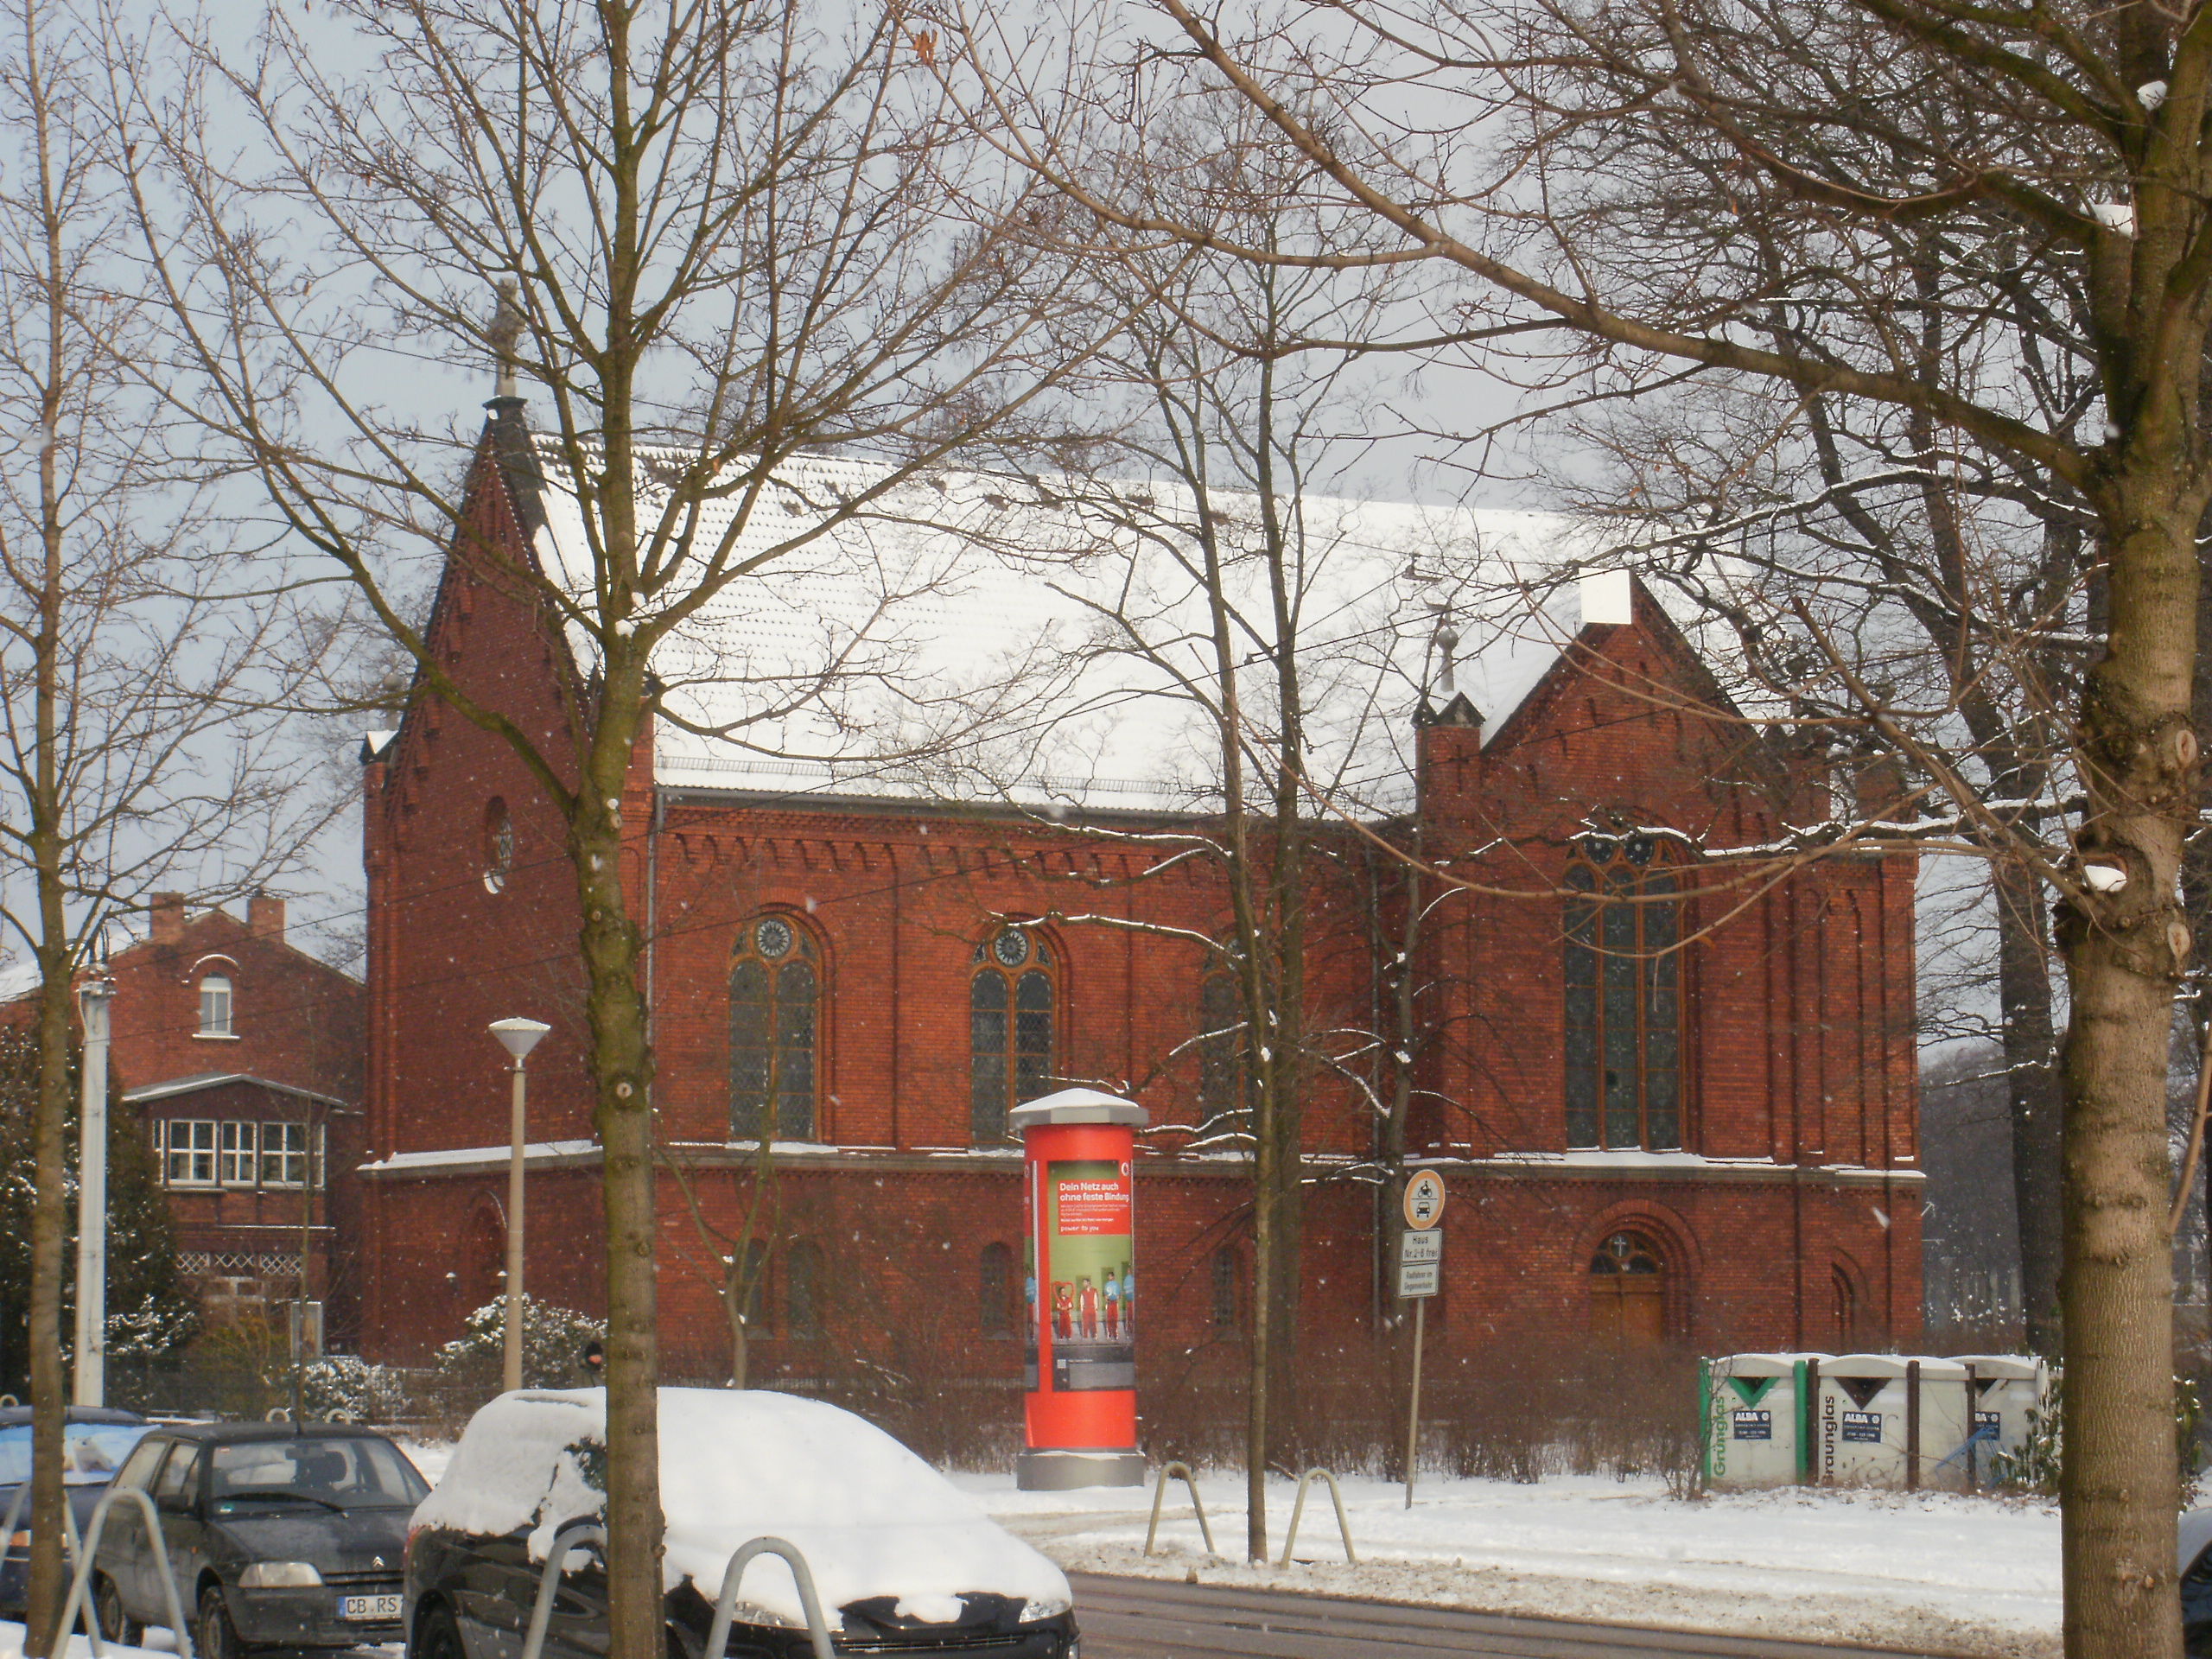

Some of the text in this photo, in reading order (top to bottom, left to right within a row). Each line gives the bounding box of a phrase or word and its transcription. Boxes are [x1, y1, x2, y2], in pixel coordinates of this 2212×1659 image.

[1059, 1182, 1119, 1192] Dein Netz auch
[1059, 1192, 1082, 1202] ohne
[1083, 1192, 1103, 1201] feste
[1413, 1235, 1429, 1245] Haus
[1426, 1247, 1439, 1258] frei
[1735, 1412, 1758, 1421] ALBA
[1844, 1413, 1868, 1423] ALBA
[1974, 1413, 1987, 1422] BA
[346, 1597, 397, 1614] CB RS
